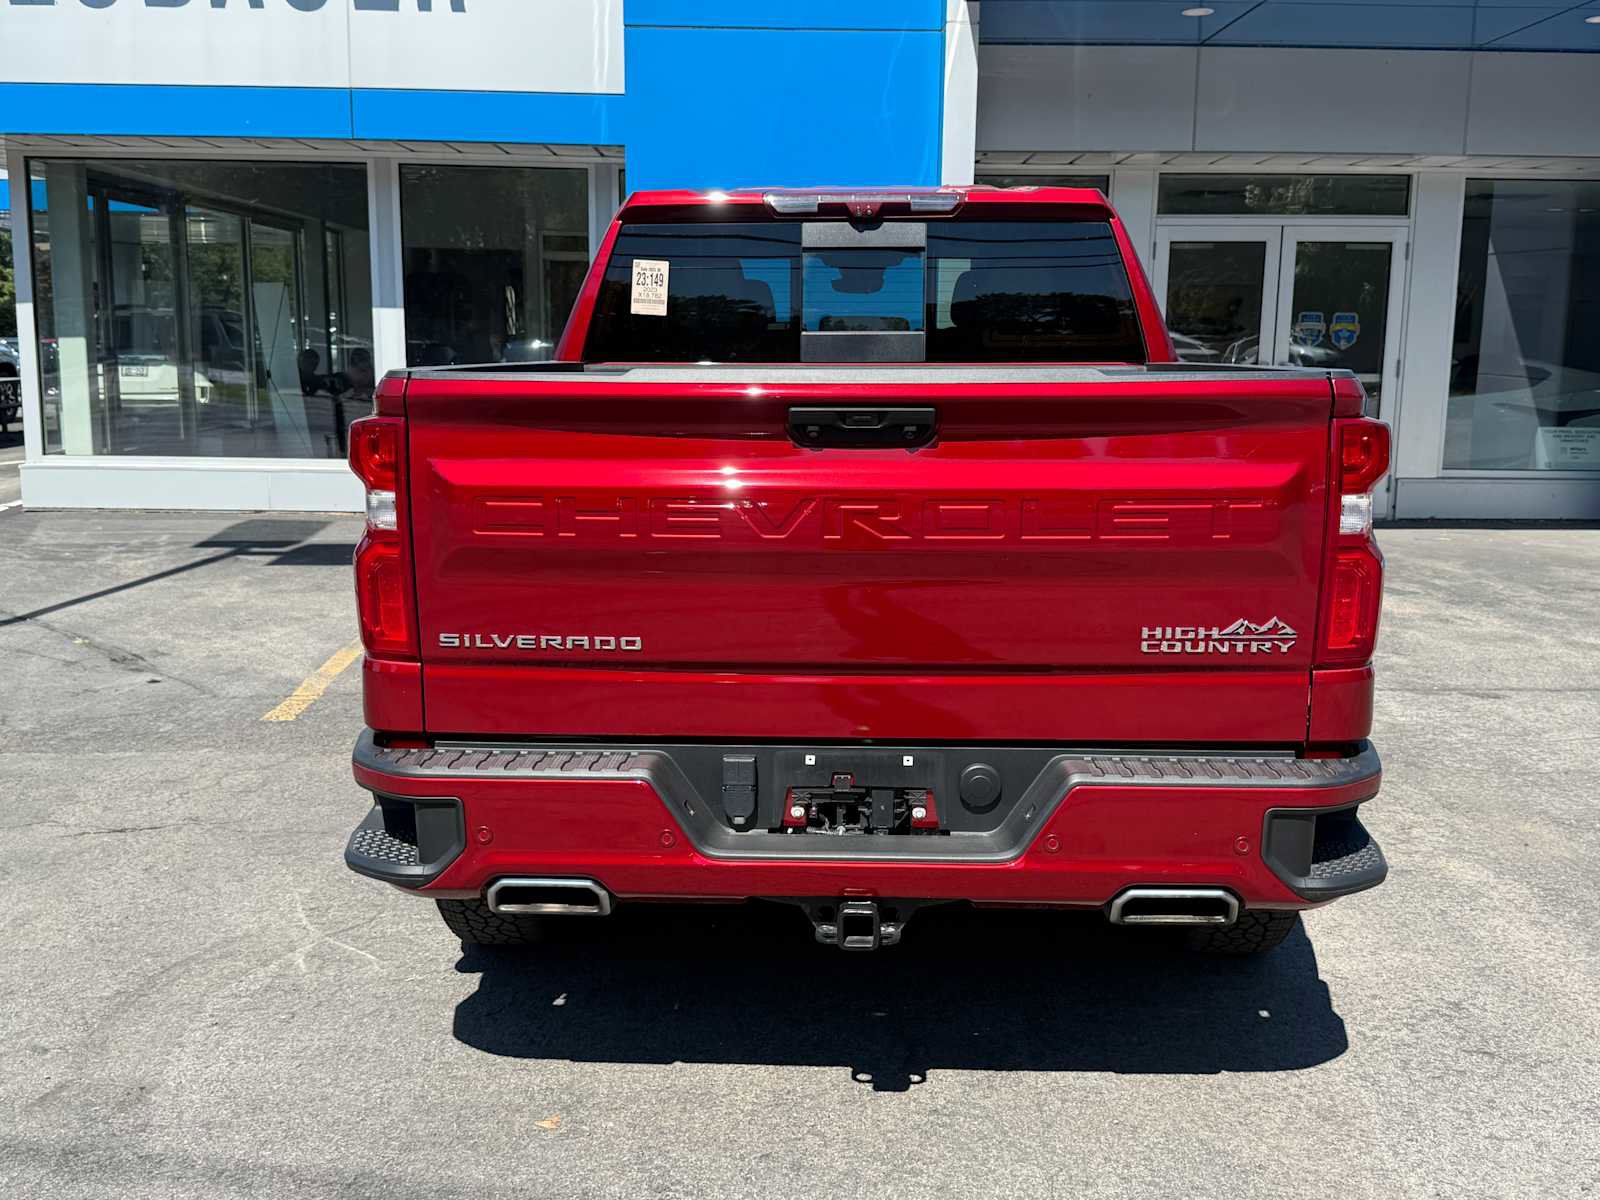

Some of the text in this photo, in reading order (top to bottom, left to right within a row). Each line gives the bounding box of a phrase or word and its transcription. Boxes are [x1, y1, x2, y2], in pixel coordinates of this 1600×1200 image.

[636, 271, 664, 287] 23:149
[472, 496, 1266, 539] CHEVROLET
[1141, 626, 1220, 640] HIGH
[438, 633, 642, 651] SILVERADO
[1140, 640, 1297, 653] COUNTRY
